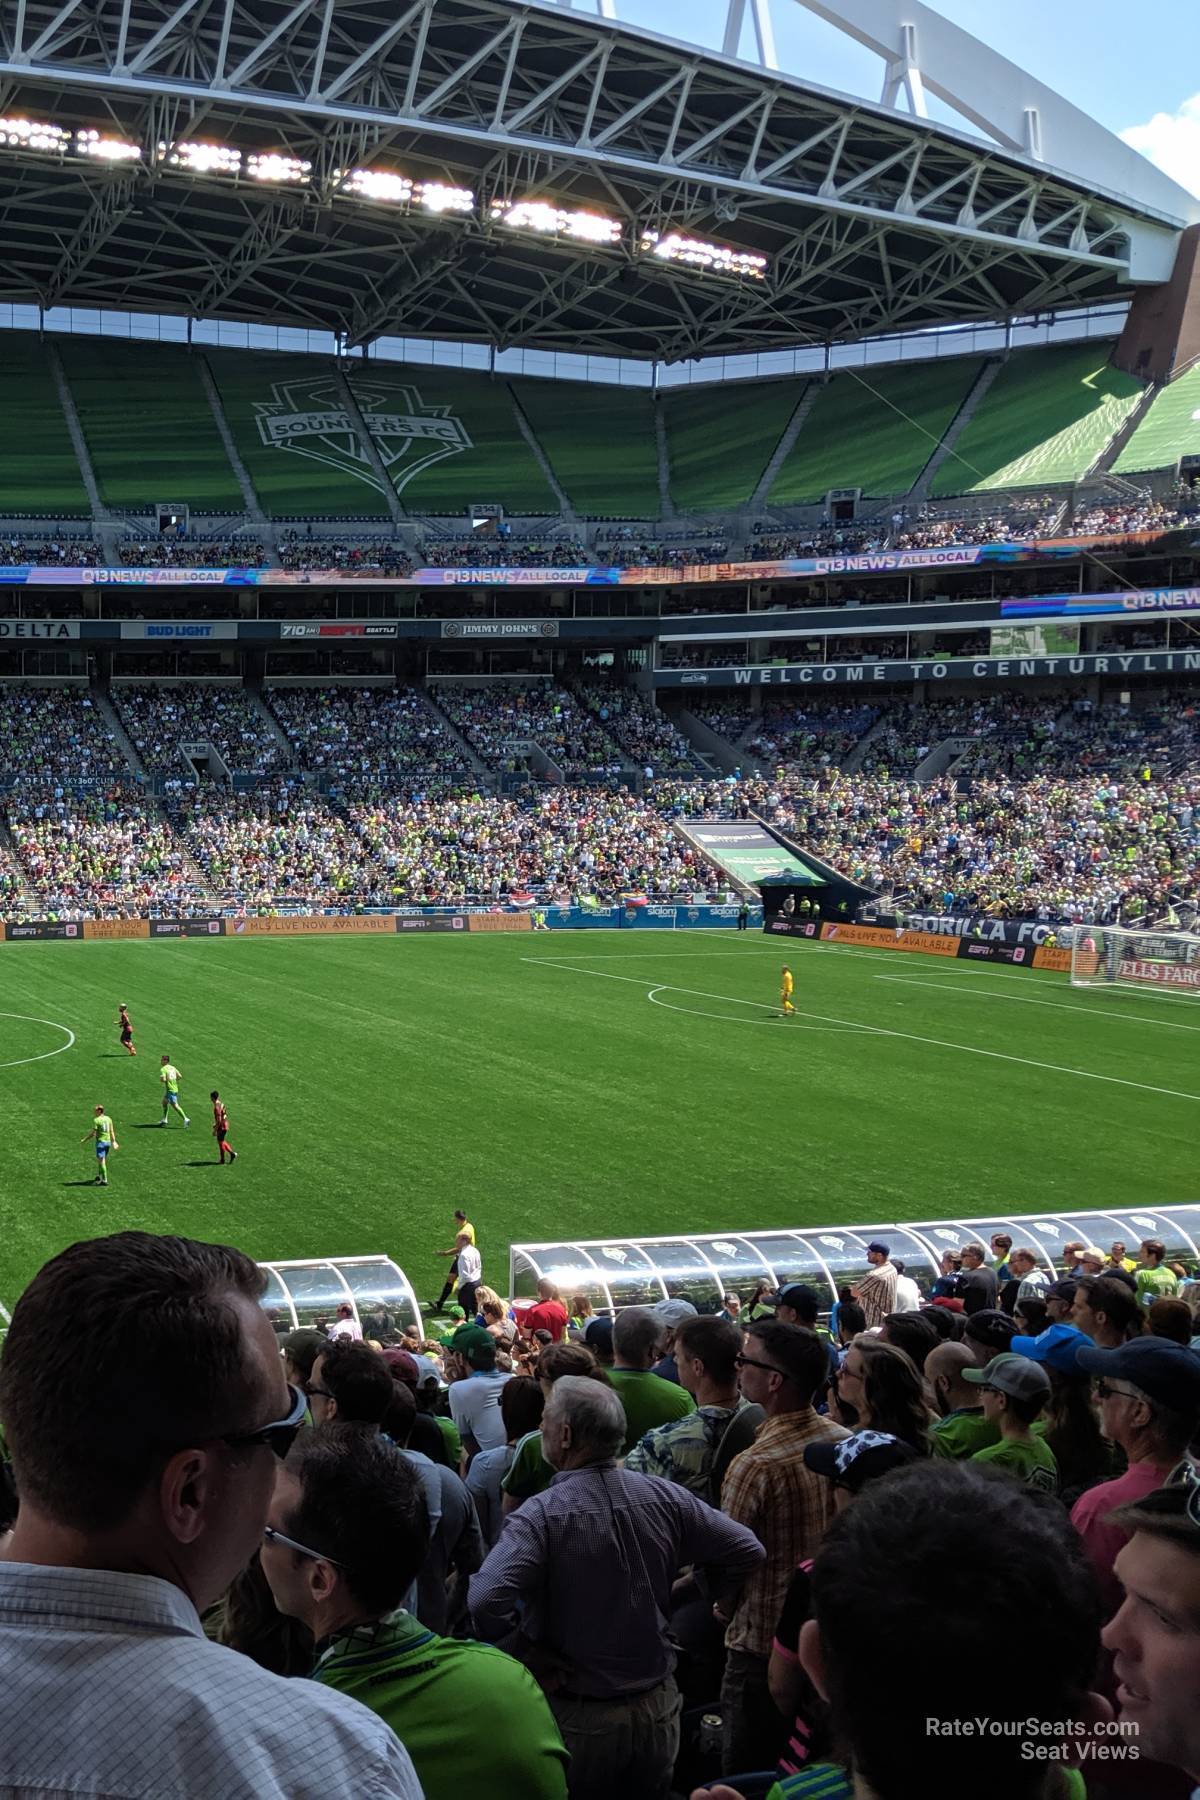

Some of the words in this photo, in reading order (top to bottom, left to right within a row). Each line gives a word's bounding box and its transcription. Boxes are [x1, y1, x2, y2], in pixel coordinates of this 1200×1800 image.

[308, 414, 407, 422] SEATLE
[423, 425, 455, 439] FC
[902, 554, 926, 565] ALL
[929, 552, 972, 564] LOCAL
[160, 571, 179, 581] ALL
[182, 571, 220, 581] LOCAL
[521, 572, 543, 581] ALL
[545, 572, 582, 581] LOCAL
[147, 626, 174, 636] BUD
[175, 626, 212, 636] LIGHT
[282, 625, 306, 636] 710
[462, 625, 498, 634] JIMMY
[500, 624, 538, 634] JOHN'S
[734, 666, 886, 683] WELCOME
[910, 665, 948, 679] TO
[647, 906, 677, 915] slalom
[710, 906, 740, 915] slalom
[123, 921, 142, 929] YOUR
[250, 922, 271, 930] MLS
[275, 921, 298, 929] LIVE
[302, 920, 328, 929] NOW
[332, 918, 389, 928] AVAILABLE
[908, 914, 1006, 942] GORILLA
[1017, 922, 1051, 946] FC
[840, 930, 856, 940] MLS
[857, 931, 876, 941] LIVE
[878, 933, 899, 944] NOW
[903, 936, 954, 951] AVAILABLE
